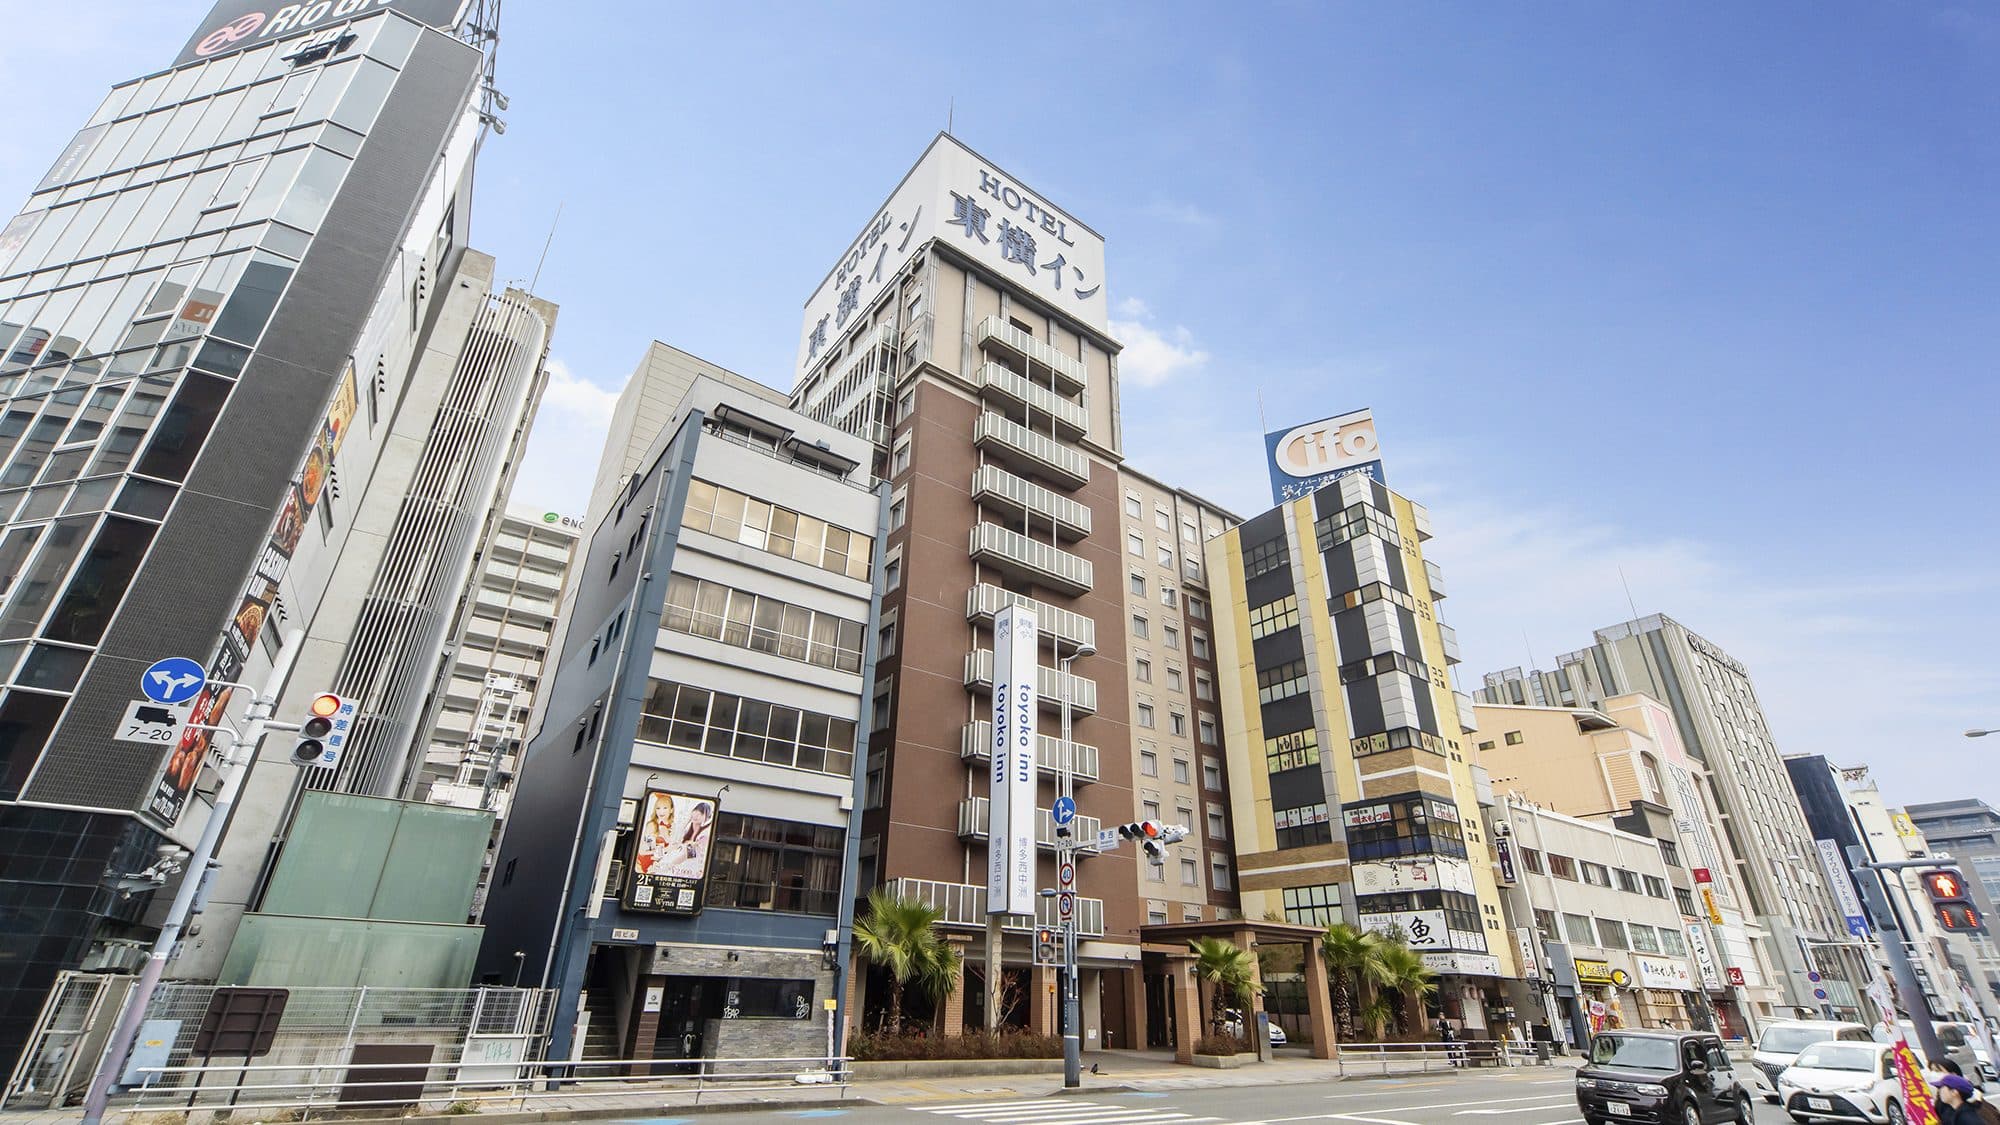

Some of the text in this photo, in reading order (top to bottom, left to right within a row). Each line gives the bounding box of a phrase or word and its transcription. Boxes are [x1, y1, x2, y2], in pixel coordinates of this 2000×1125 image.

[258, 0, 332, 38] Rio
[979, 169, 1075, 248] HOTEL
[834, 211, 893, 291] HOTEL
[945, 189, 1100, 300] 東横イン
[804, 204, 922, 368] 東横イン
[127, 726, 173, 741] 7-20
[323, 703, 354, 763] 時差信号
[996, 683, 1007, 783] toyoko inn
[1017, 684, 1031, 782] toyoko inn
[636, 873, 654, 886] 2F
[655, 897, 675, 908] Wynn
[1062, 868, 1072, 880] 40
[1409, 915, 1436, 946] 魚
